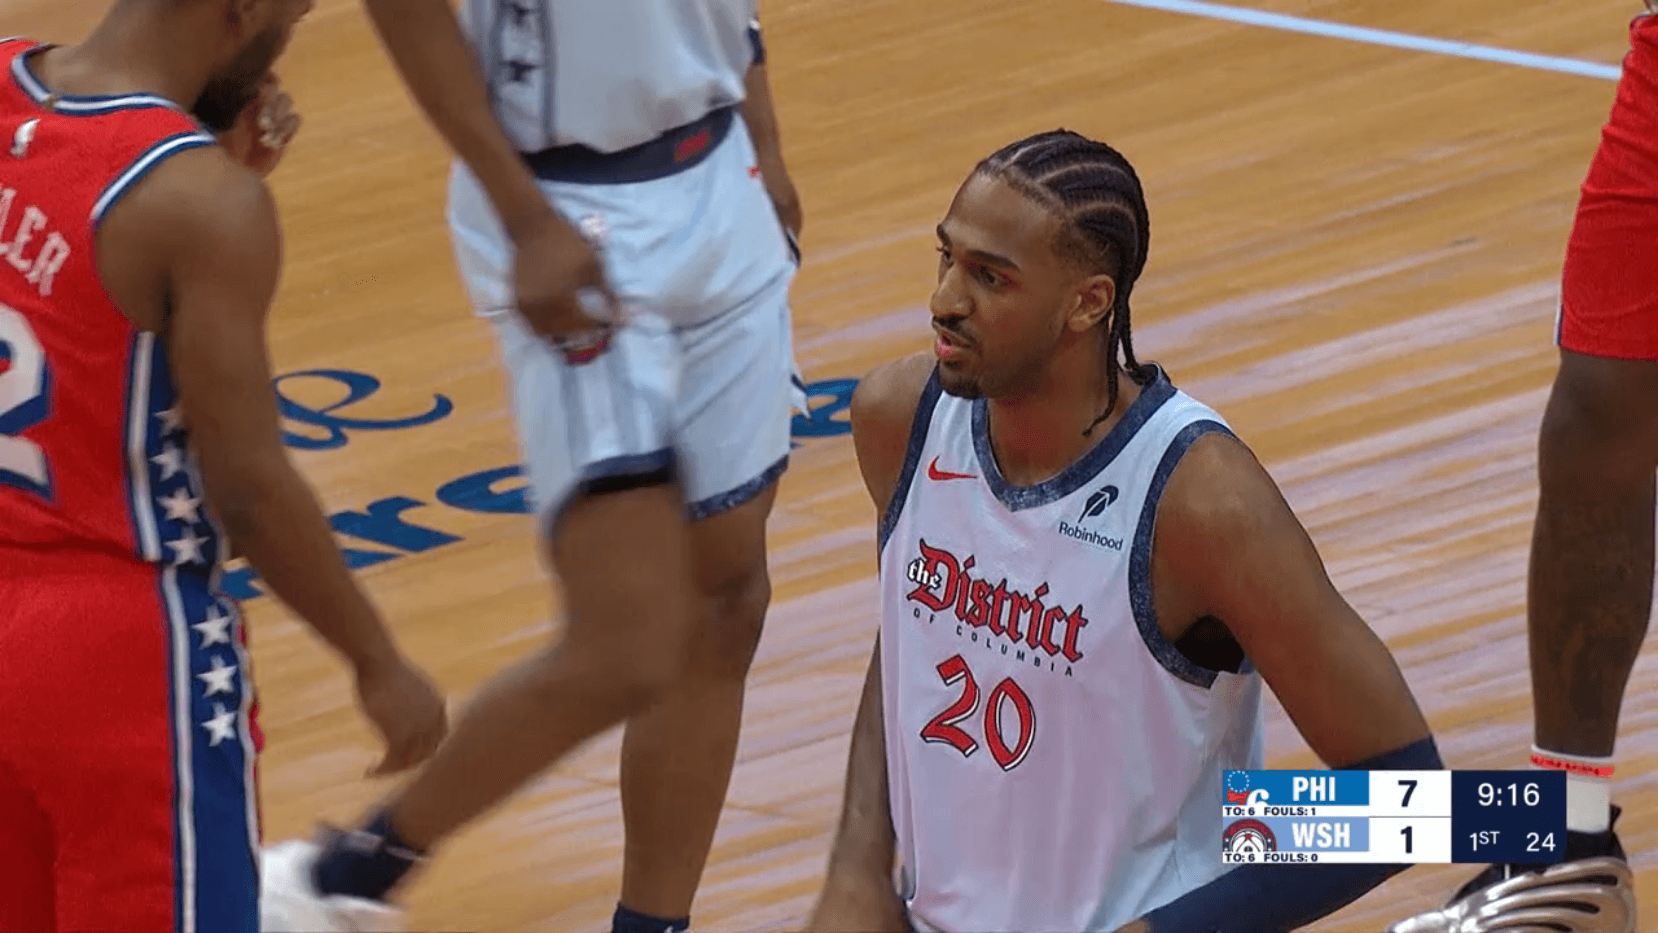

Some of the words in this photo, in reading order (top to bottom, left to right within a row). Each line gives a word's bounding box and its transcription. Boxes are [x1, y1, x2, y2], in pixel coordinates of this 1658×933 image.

[1058, 521, 1123, 551] Robinhood
[907, 538, 1089, 663] District
[908, 557, 941, 589] the
[912, 608, 936, 624] OF
[956, 625, 1074, 677] COLUMBIA
[919, 654, 1037, 772] 20
